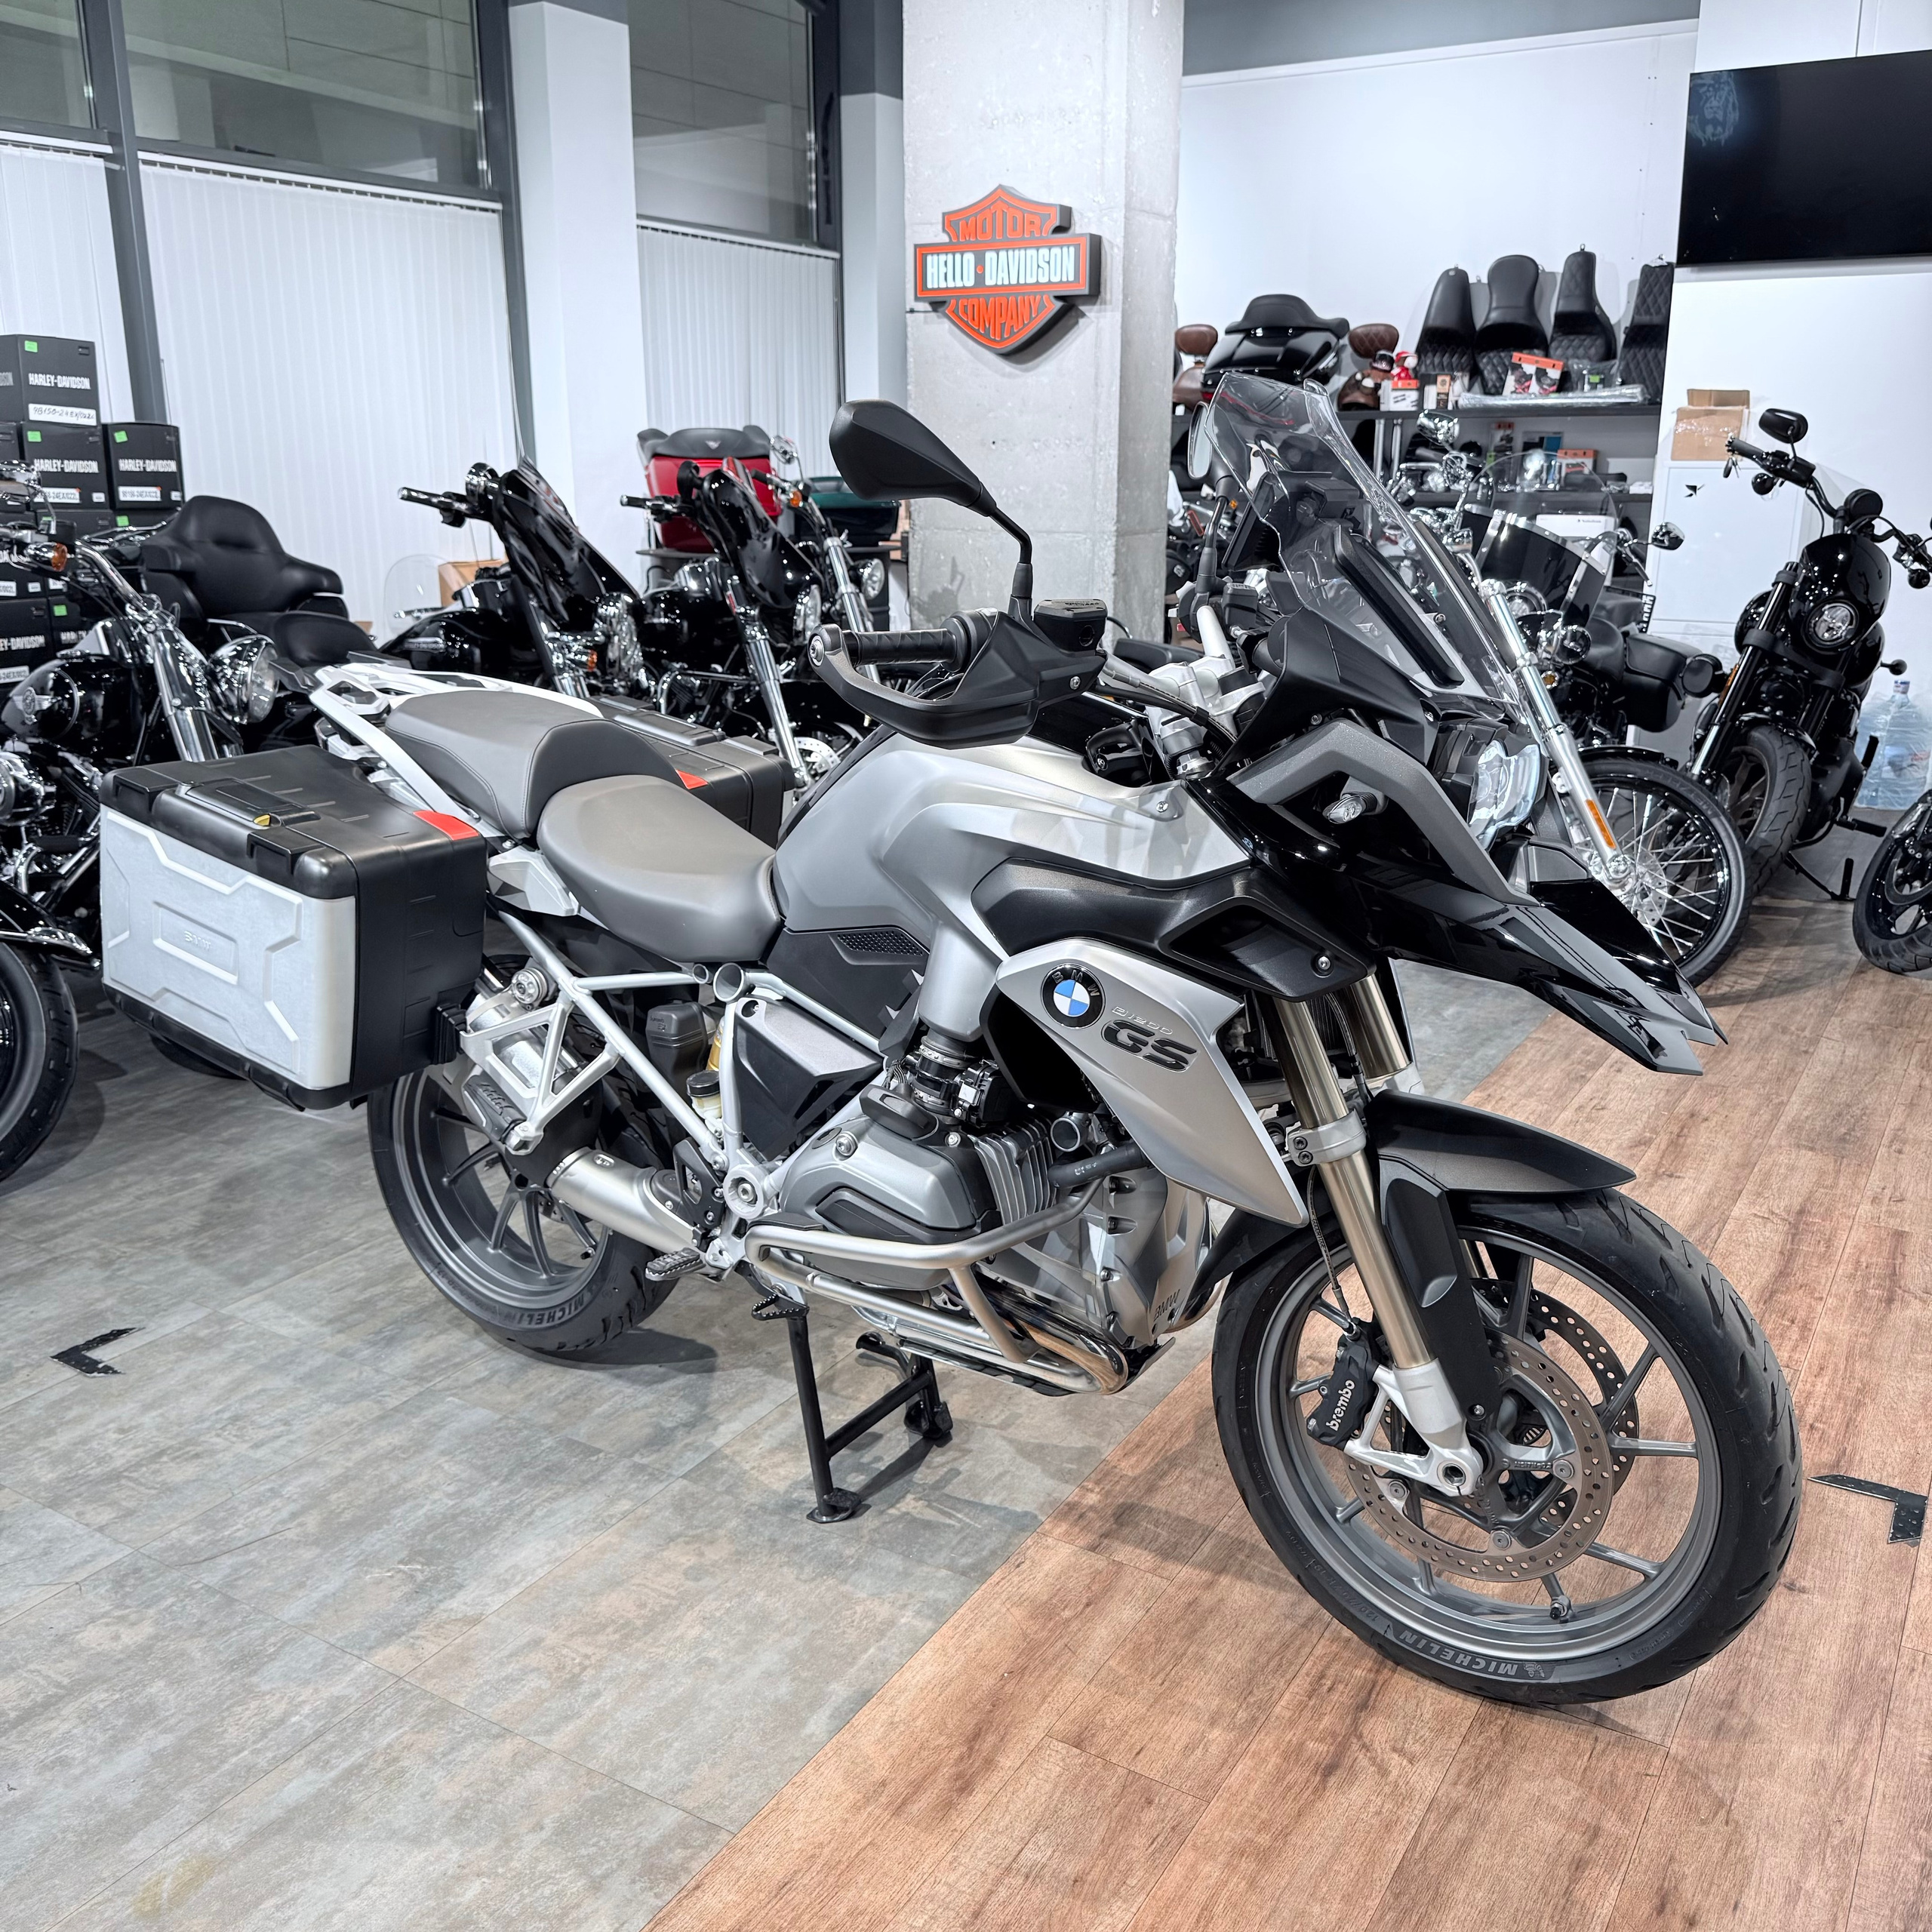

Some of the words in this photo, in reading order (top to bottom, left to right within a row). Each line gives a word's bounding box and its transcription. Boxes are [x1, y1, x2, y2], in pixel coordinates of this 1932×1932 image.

[959, 200, 1041, 242] MOTOR
[926, 252, 975, 288] HELLO
[985, 246, 1075, 286] DAVIDSON
[958, 294, 1041, 340] COMPANY
[28, 373, 91, 389] HARLEY-DAVIDSON
[34, 459, 100, 473] HARLEY-DAVIDSON
[118, 459, 177, 472] HARLEY-DAVIDSON
[1052, 970, 1100, 997] BMW
[1101, 1020, 1198, 1072] GS
[504, 1293, 585, 1325] MICHELIN
[1153, 1289, 1180, 1322] BMW
[1326, 1380, 1355, 1432] brembo
[1399, 1630, 1518, 1675] MICHELIN
